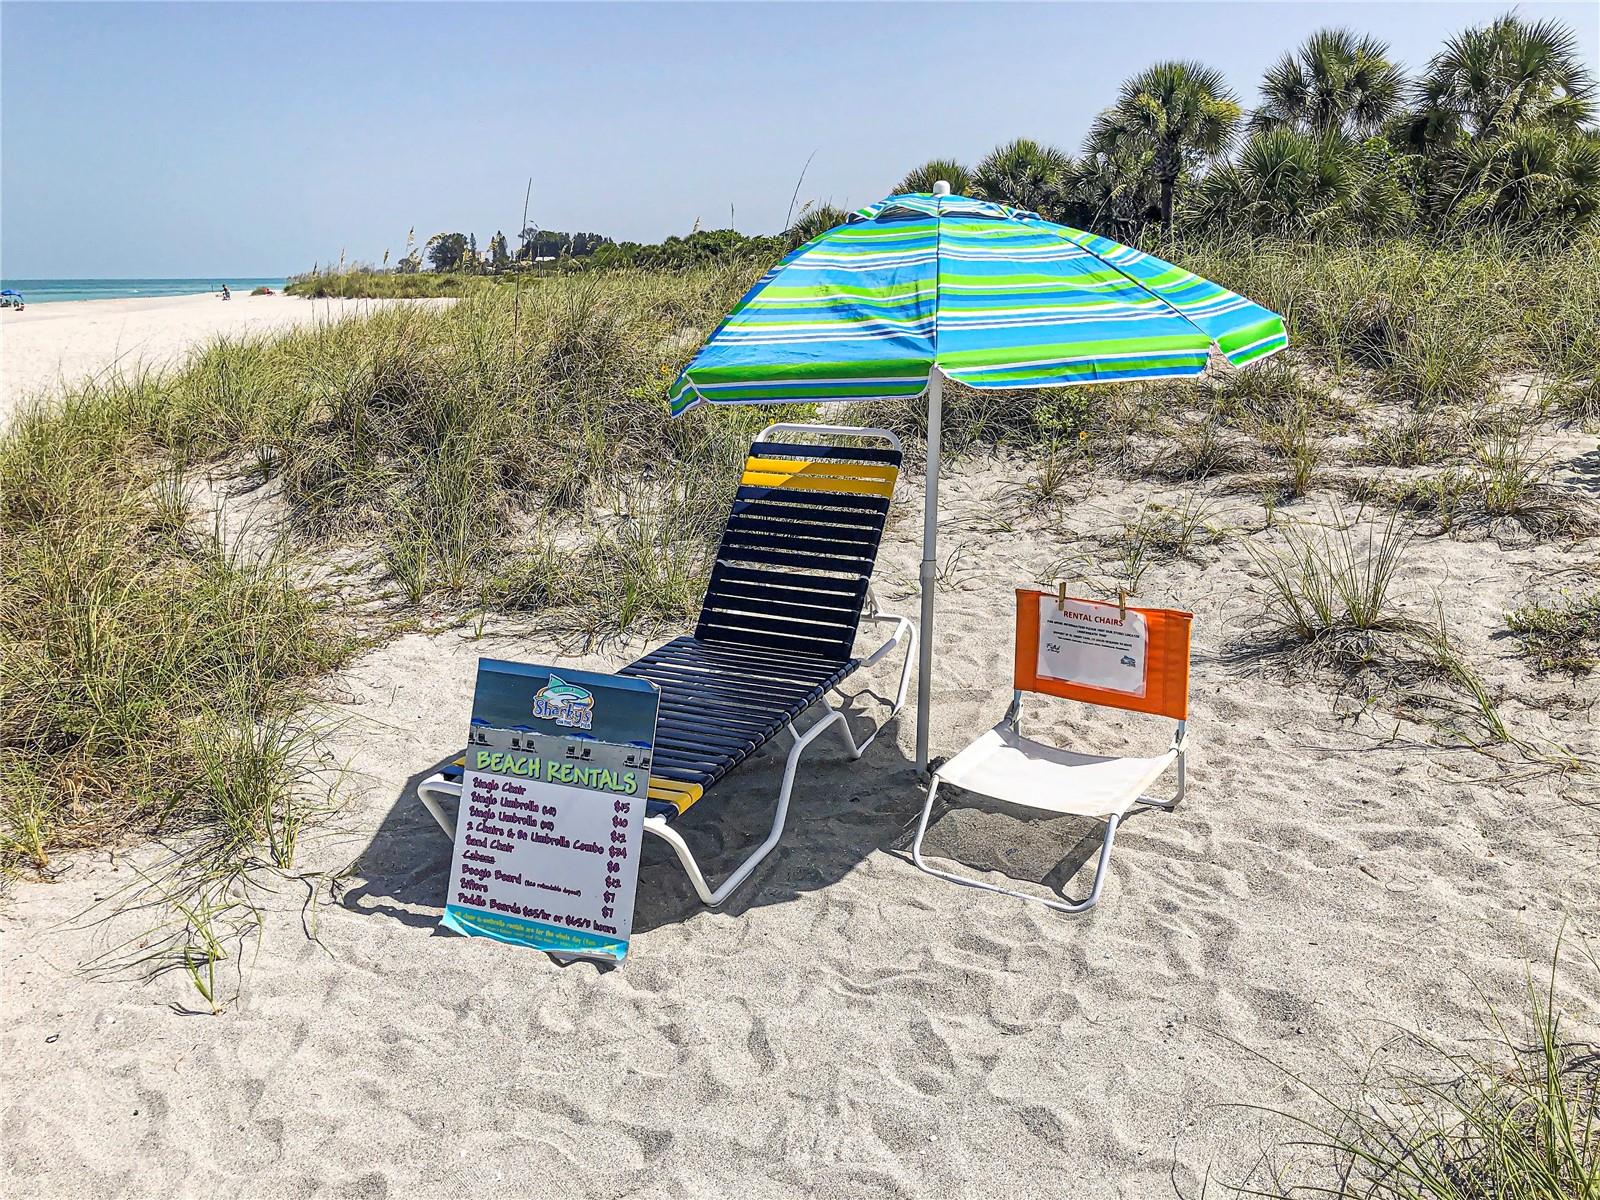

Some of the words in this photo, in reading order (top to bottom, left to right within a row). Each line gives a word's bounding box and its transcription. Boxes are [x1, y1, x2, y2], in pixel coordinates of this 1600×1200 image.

[1063, 611, 1092, 622] RENTAL
[1095, 616, 1124, 627] CHAIRS
[535, 699, 592, 724] Sharky's
[476, 750, 541, 779] BEACH
[547, 761, 638, 795] RENTALS
[473, 777, 500, 793] Single
[502, 782, 526, 796] Chair
[471, 792, 498, 808] Single
[500, 796, 539, 813] Umbrella
[614, 800, 630, 814] $15
[469, 806, 496, 822] Single
[498, 811, 537, 827] Umbrella
[612, 815, 628, 828] $10
[465, 834, 488, 848] Sand
[490, 839, 514, 853] Chair
[467, 821, 474, 831] 2
[476, 822, 505, 836] Chairs
[530, 832, 570, 848] Umbrella
[572, 840, 604, 855] Combo
[610, 830, 627, 844] $12
[461, 850, 496, 864] Cabana
[462, 864, 492, 881] Boogie
[494, 870, 522, 885] Board
[605, 875, 622, 889] $12
[603, 890, 616, 904] $7
[458, 892, 486, 907] Paddle
[490, 899, 522, 914] Boards
[553, 914, 563, 923] or
[593, 920, 617, 934] hours
[602, 905, 614, 919] $7
